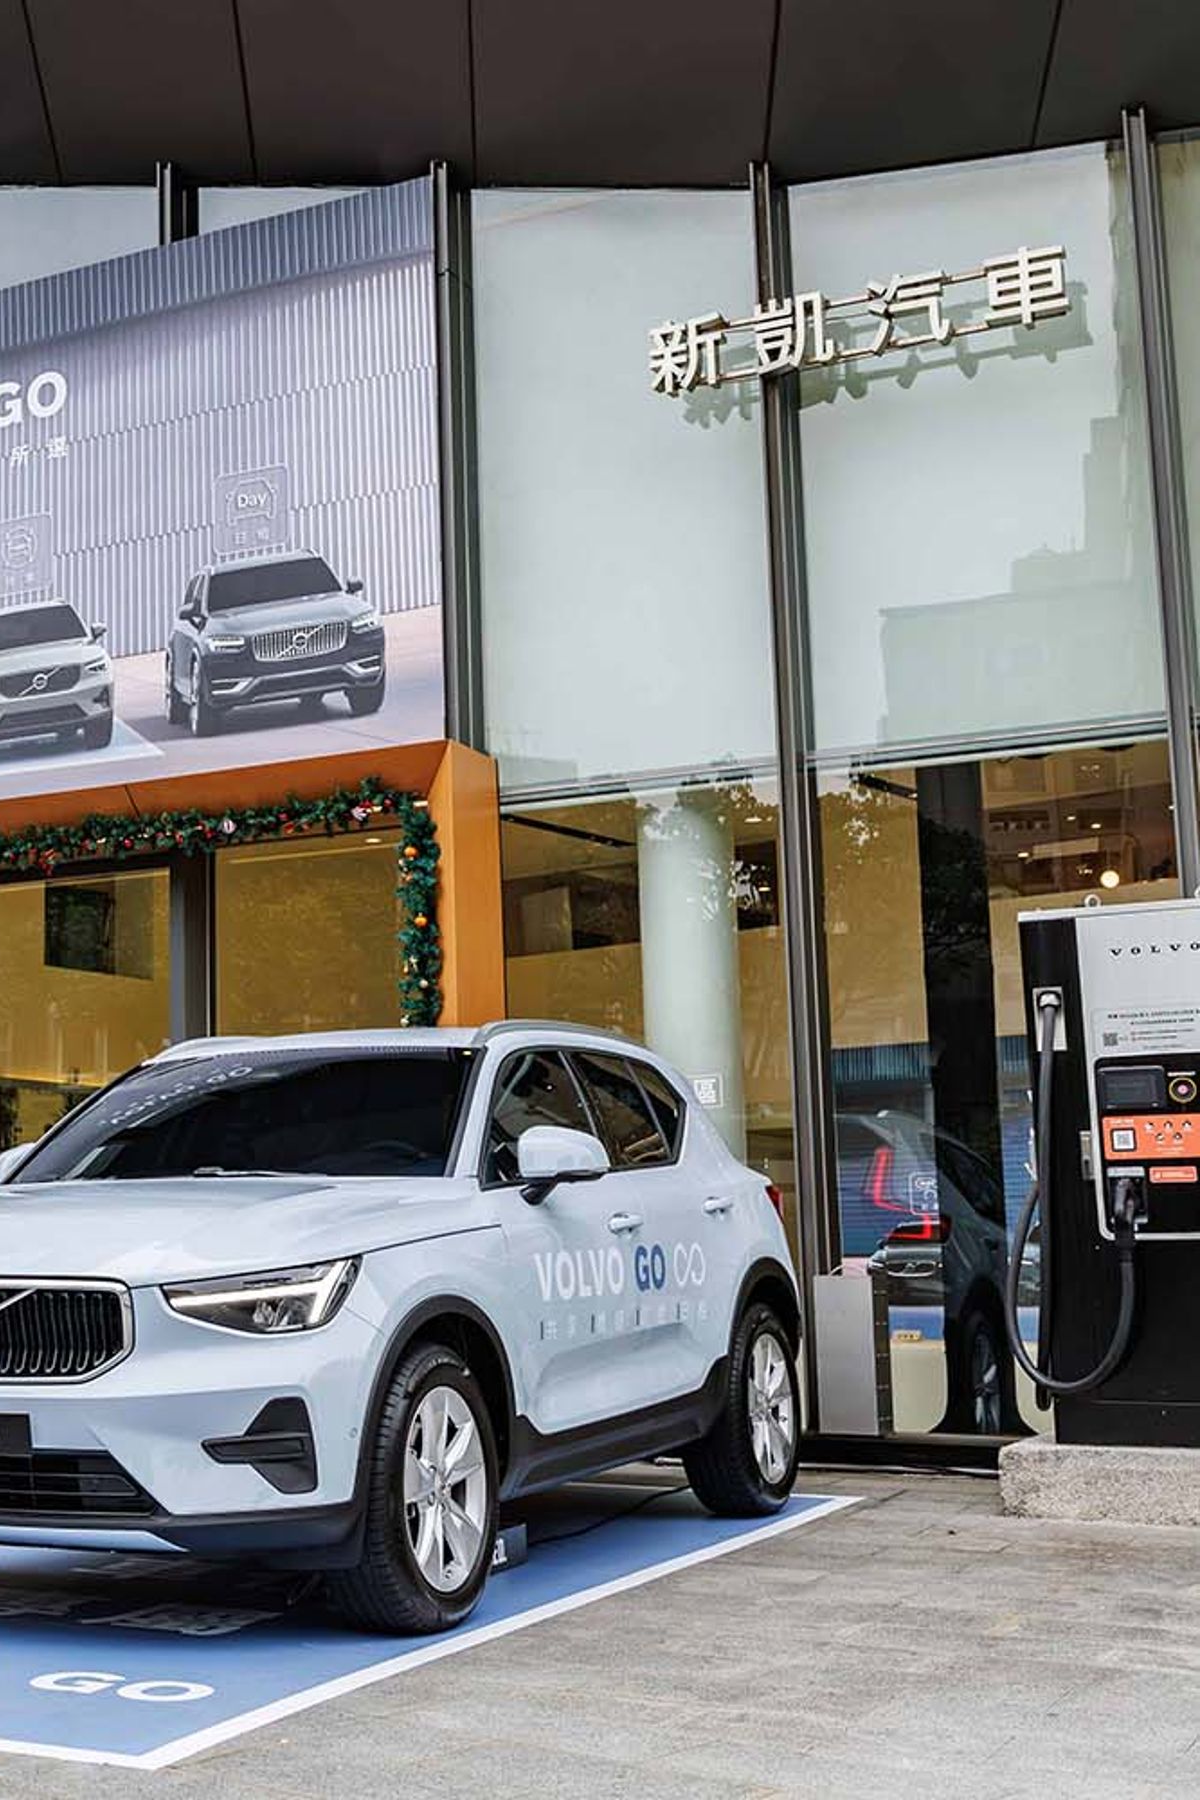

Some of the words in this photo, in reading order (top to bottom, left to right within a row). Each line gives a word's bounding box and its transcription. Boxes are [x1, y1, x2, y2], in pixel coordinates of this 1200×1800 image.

[649, 246, 1069, 395] 新凱汽車
[237, 492, 267, 508] Day
[1110, 942, 1200, 956] VOLVO
[534, 1246, 624, 1300] VOLVO
[635, 1244, 665, 1291] GO
[28, 1671, 215, 1702] GO
